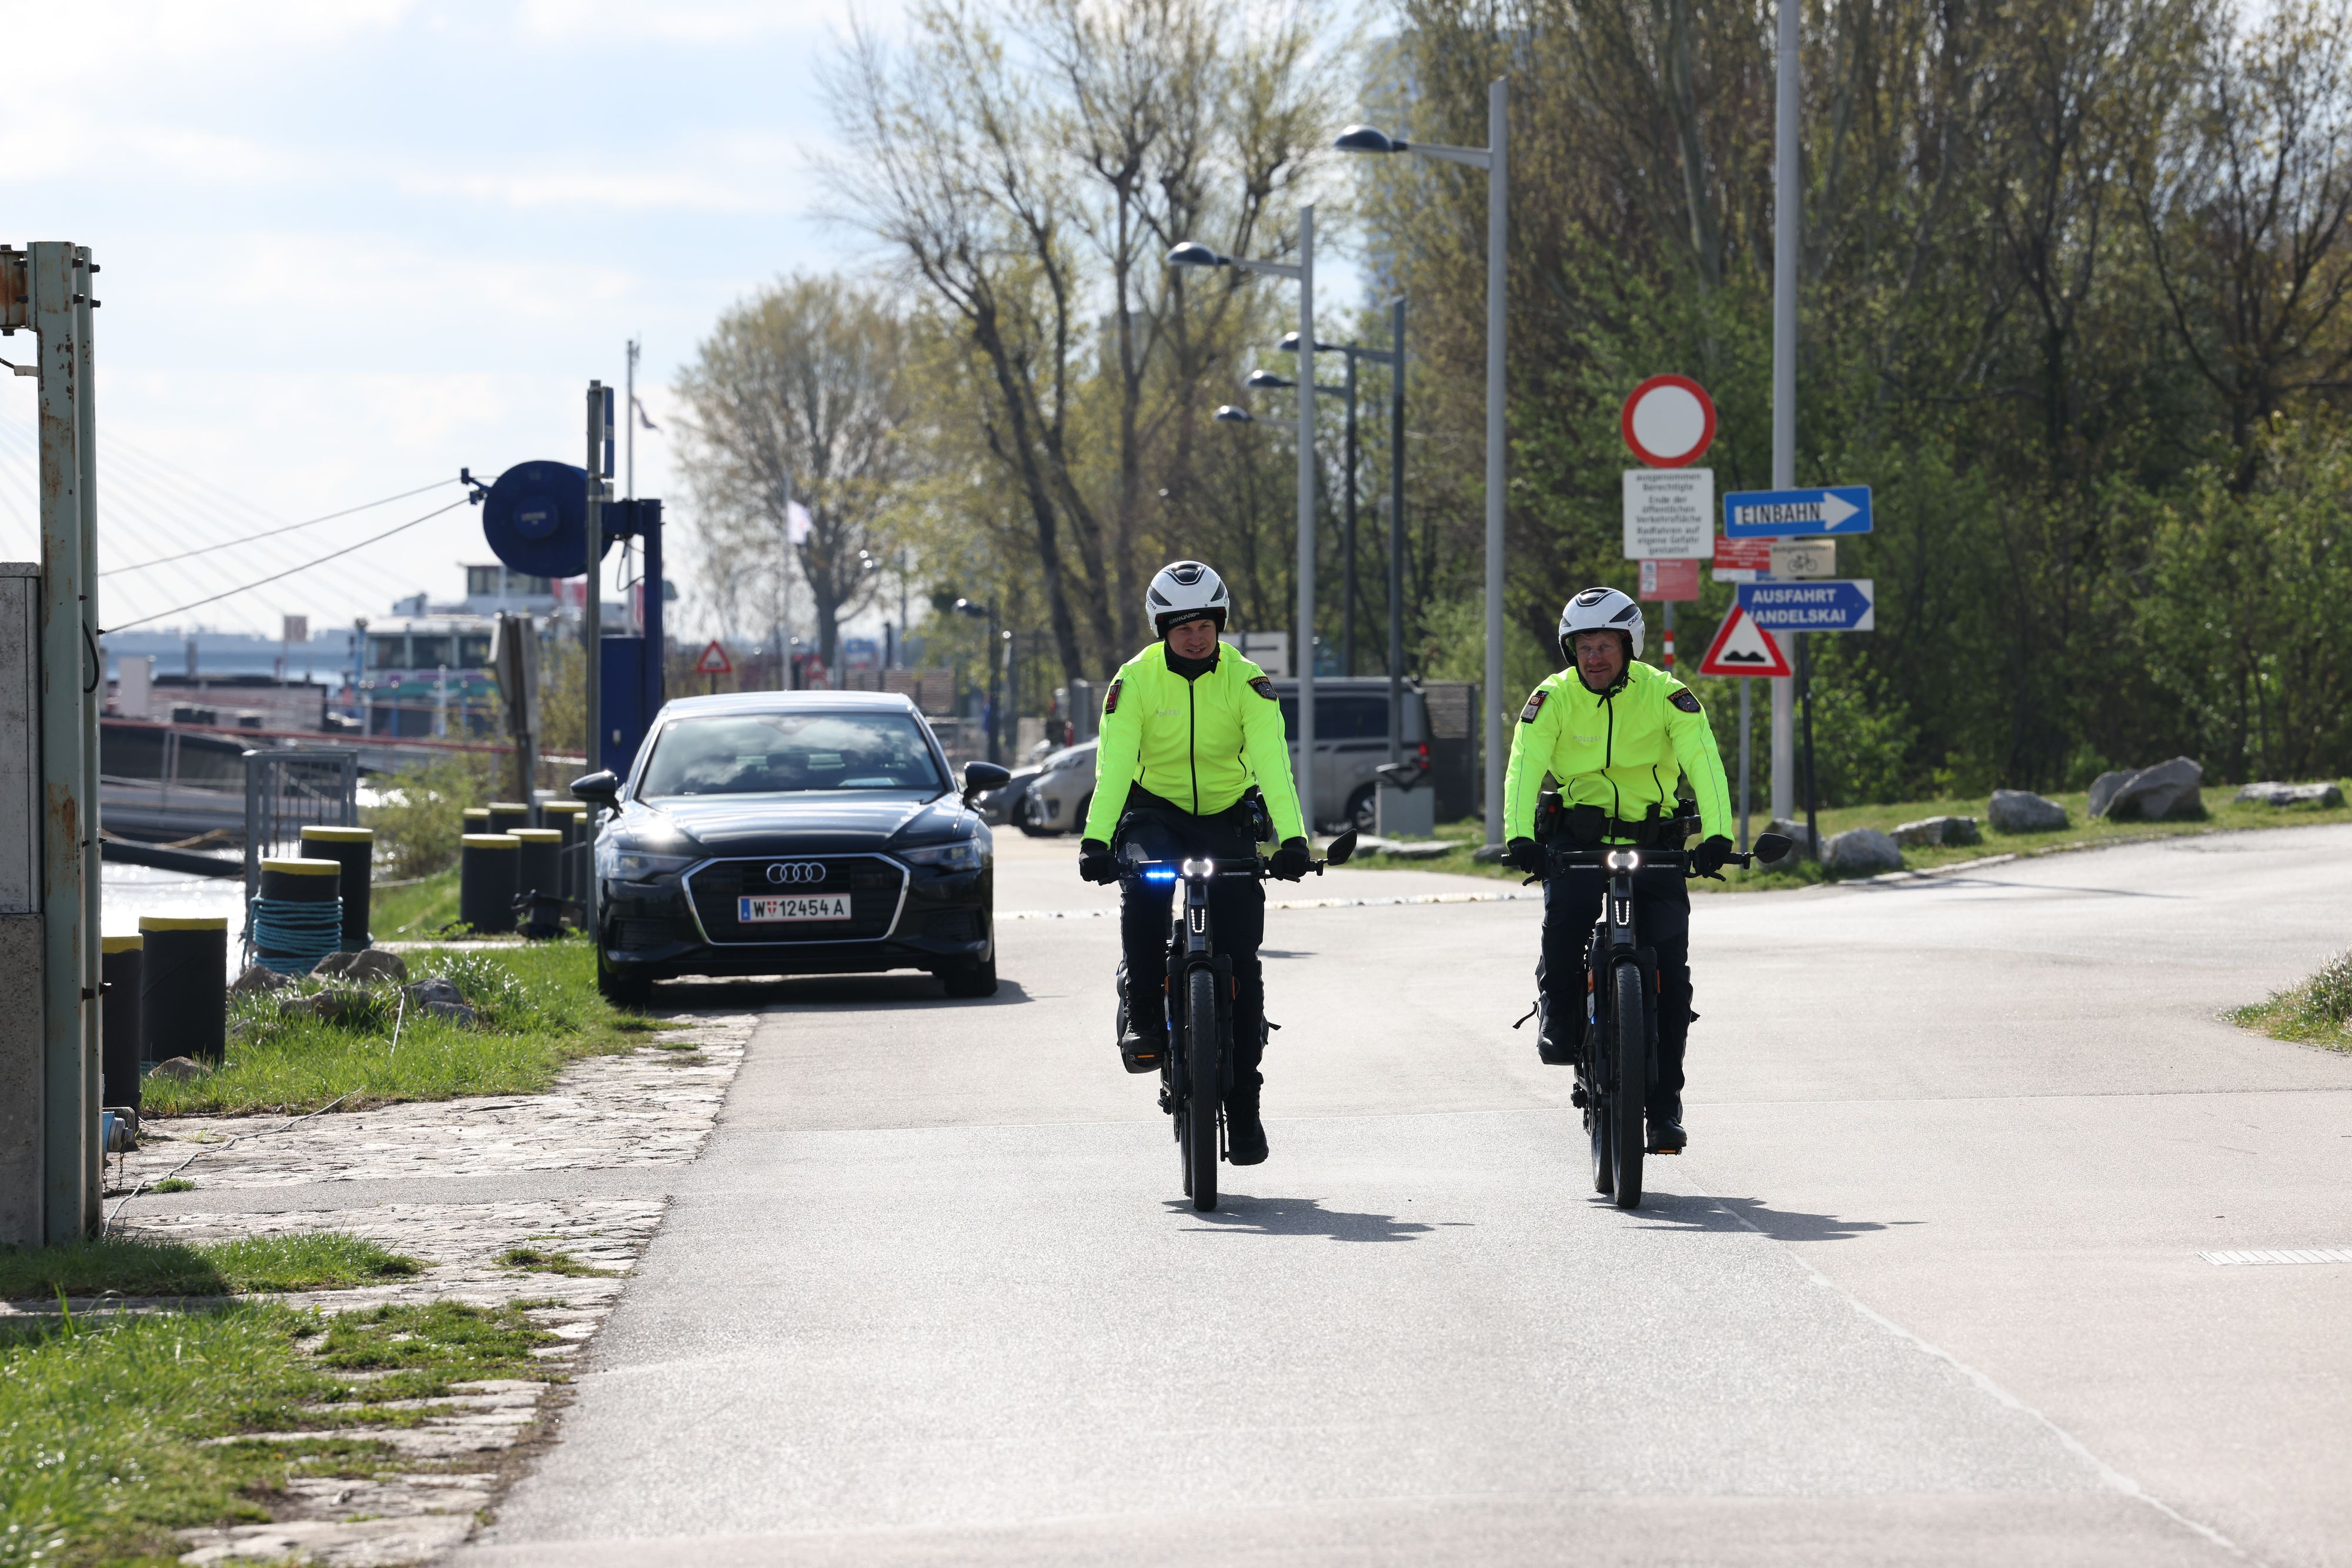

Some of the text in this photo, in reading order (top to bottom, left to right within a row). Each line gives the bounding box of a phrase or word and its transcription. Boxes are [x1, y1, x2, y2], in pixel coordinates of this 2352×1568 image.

[1636, 474, 1702, 482] ausgenommen
[1643, 483, 1693, 492] Berechtigte
[1742, 502, 1820, 524] EINBAHN
[1685, 526, 1700, 534] auf
[1752, 589, 1837, 603] AUSFAHRT
[753, 898, 844, 918] W 12454 A
